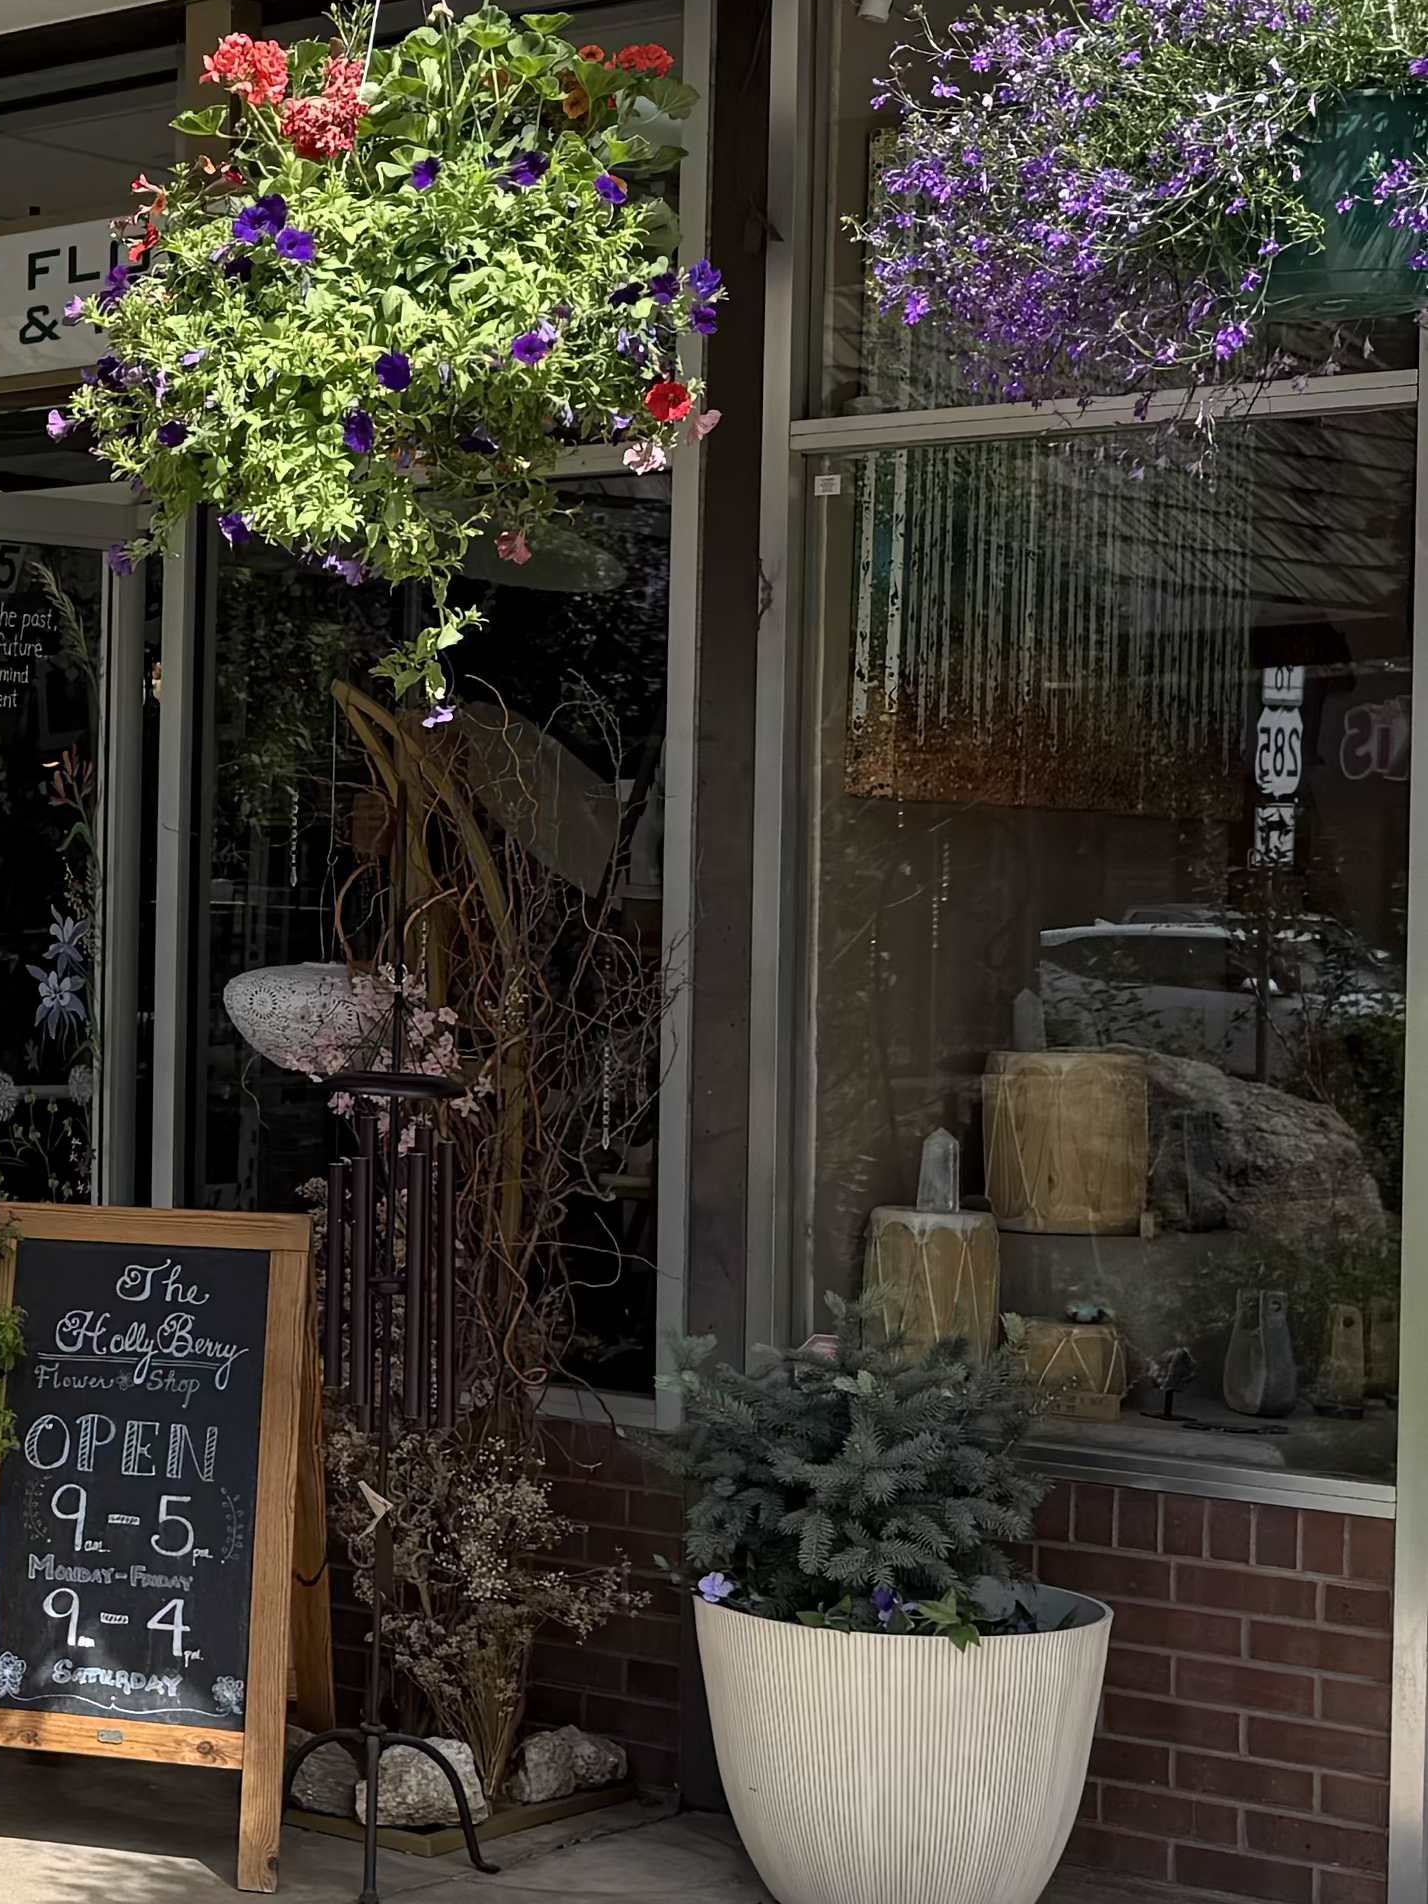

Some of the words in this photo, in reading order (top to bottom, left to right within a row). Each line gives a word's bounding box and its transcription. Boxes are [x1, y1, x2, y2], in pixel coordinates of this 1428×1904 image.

[19, 304, 62, 344] &
[115, 1258, 210, 1304] The
[33, 1362, 115, 1389] Flower
[146, 1369, 200, 1408] Shop
[24, 1414, 218, 1482] OPEN
[51, 1659, 184, 1696] SATURDAY
